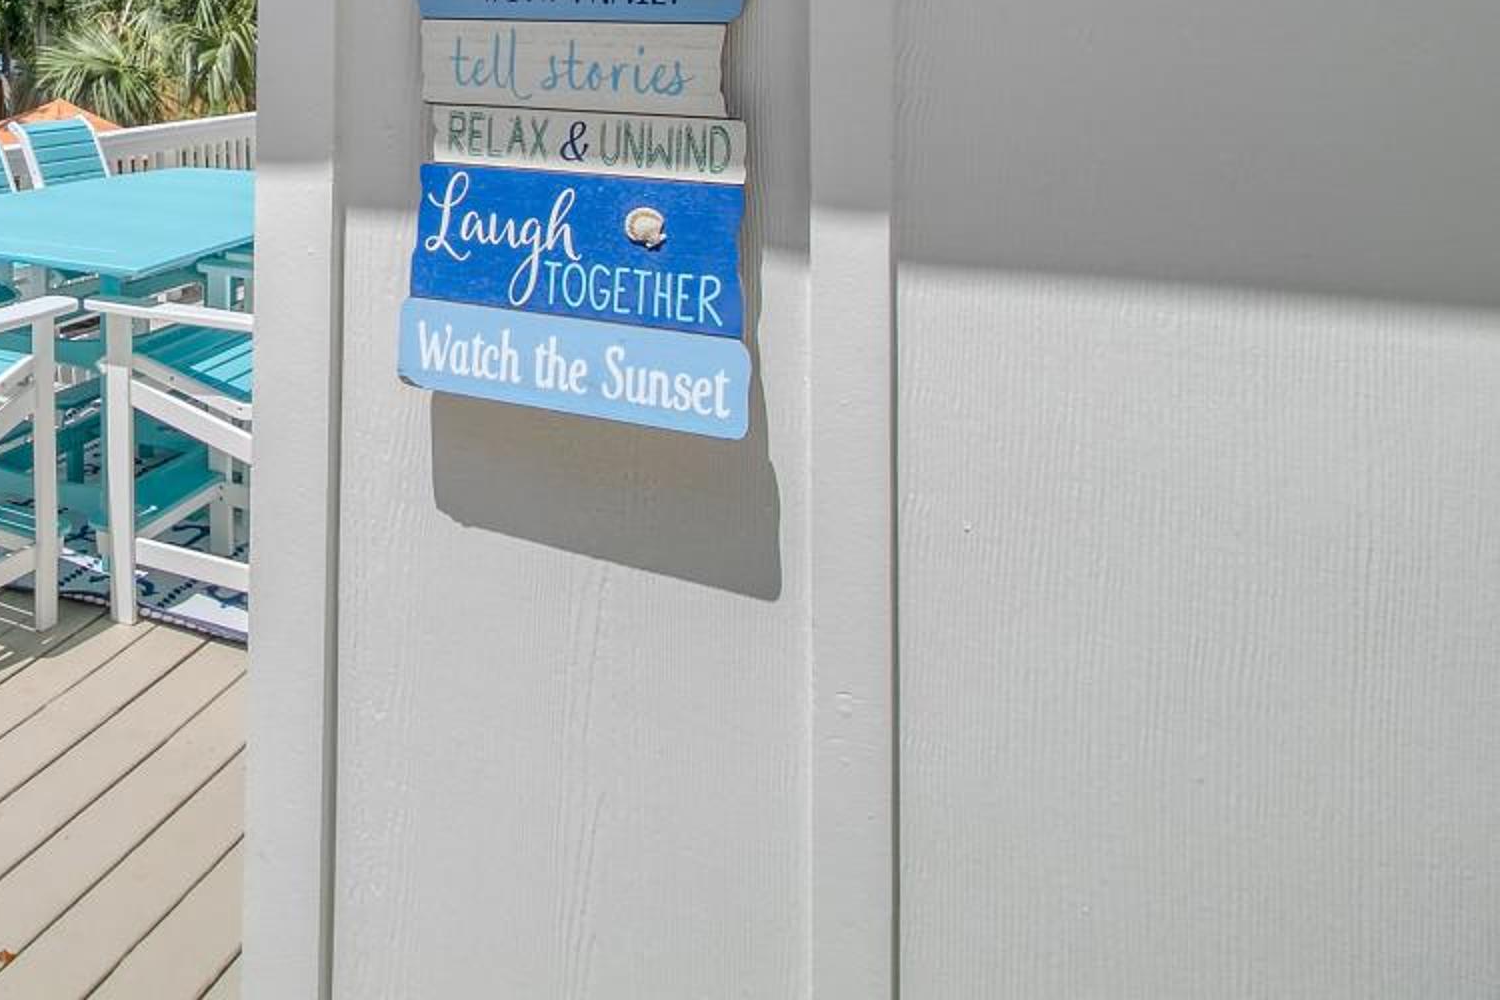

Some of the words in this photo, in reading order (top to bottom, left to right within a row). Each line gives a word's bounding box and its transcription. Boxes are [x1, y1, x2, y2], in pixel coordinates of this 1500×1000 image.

[450, 28, 532, 100] tell
[541, 39, 694, 97] stories
[447, 110, 549, 156] RELAX
[560, 120, 588, 161] &
[600, 120, 732, 173] UNWIND
[425, 172, 581, 306] Laugh
[544, 260, 723, 326] TOGETHER
[418, 320, 520, 384] Watch
[535, 336, 588, 394] the
[602, 346, 731, 419] Sunset
